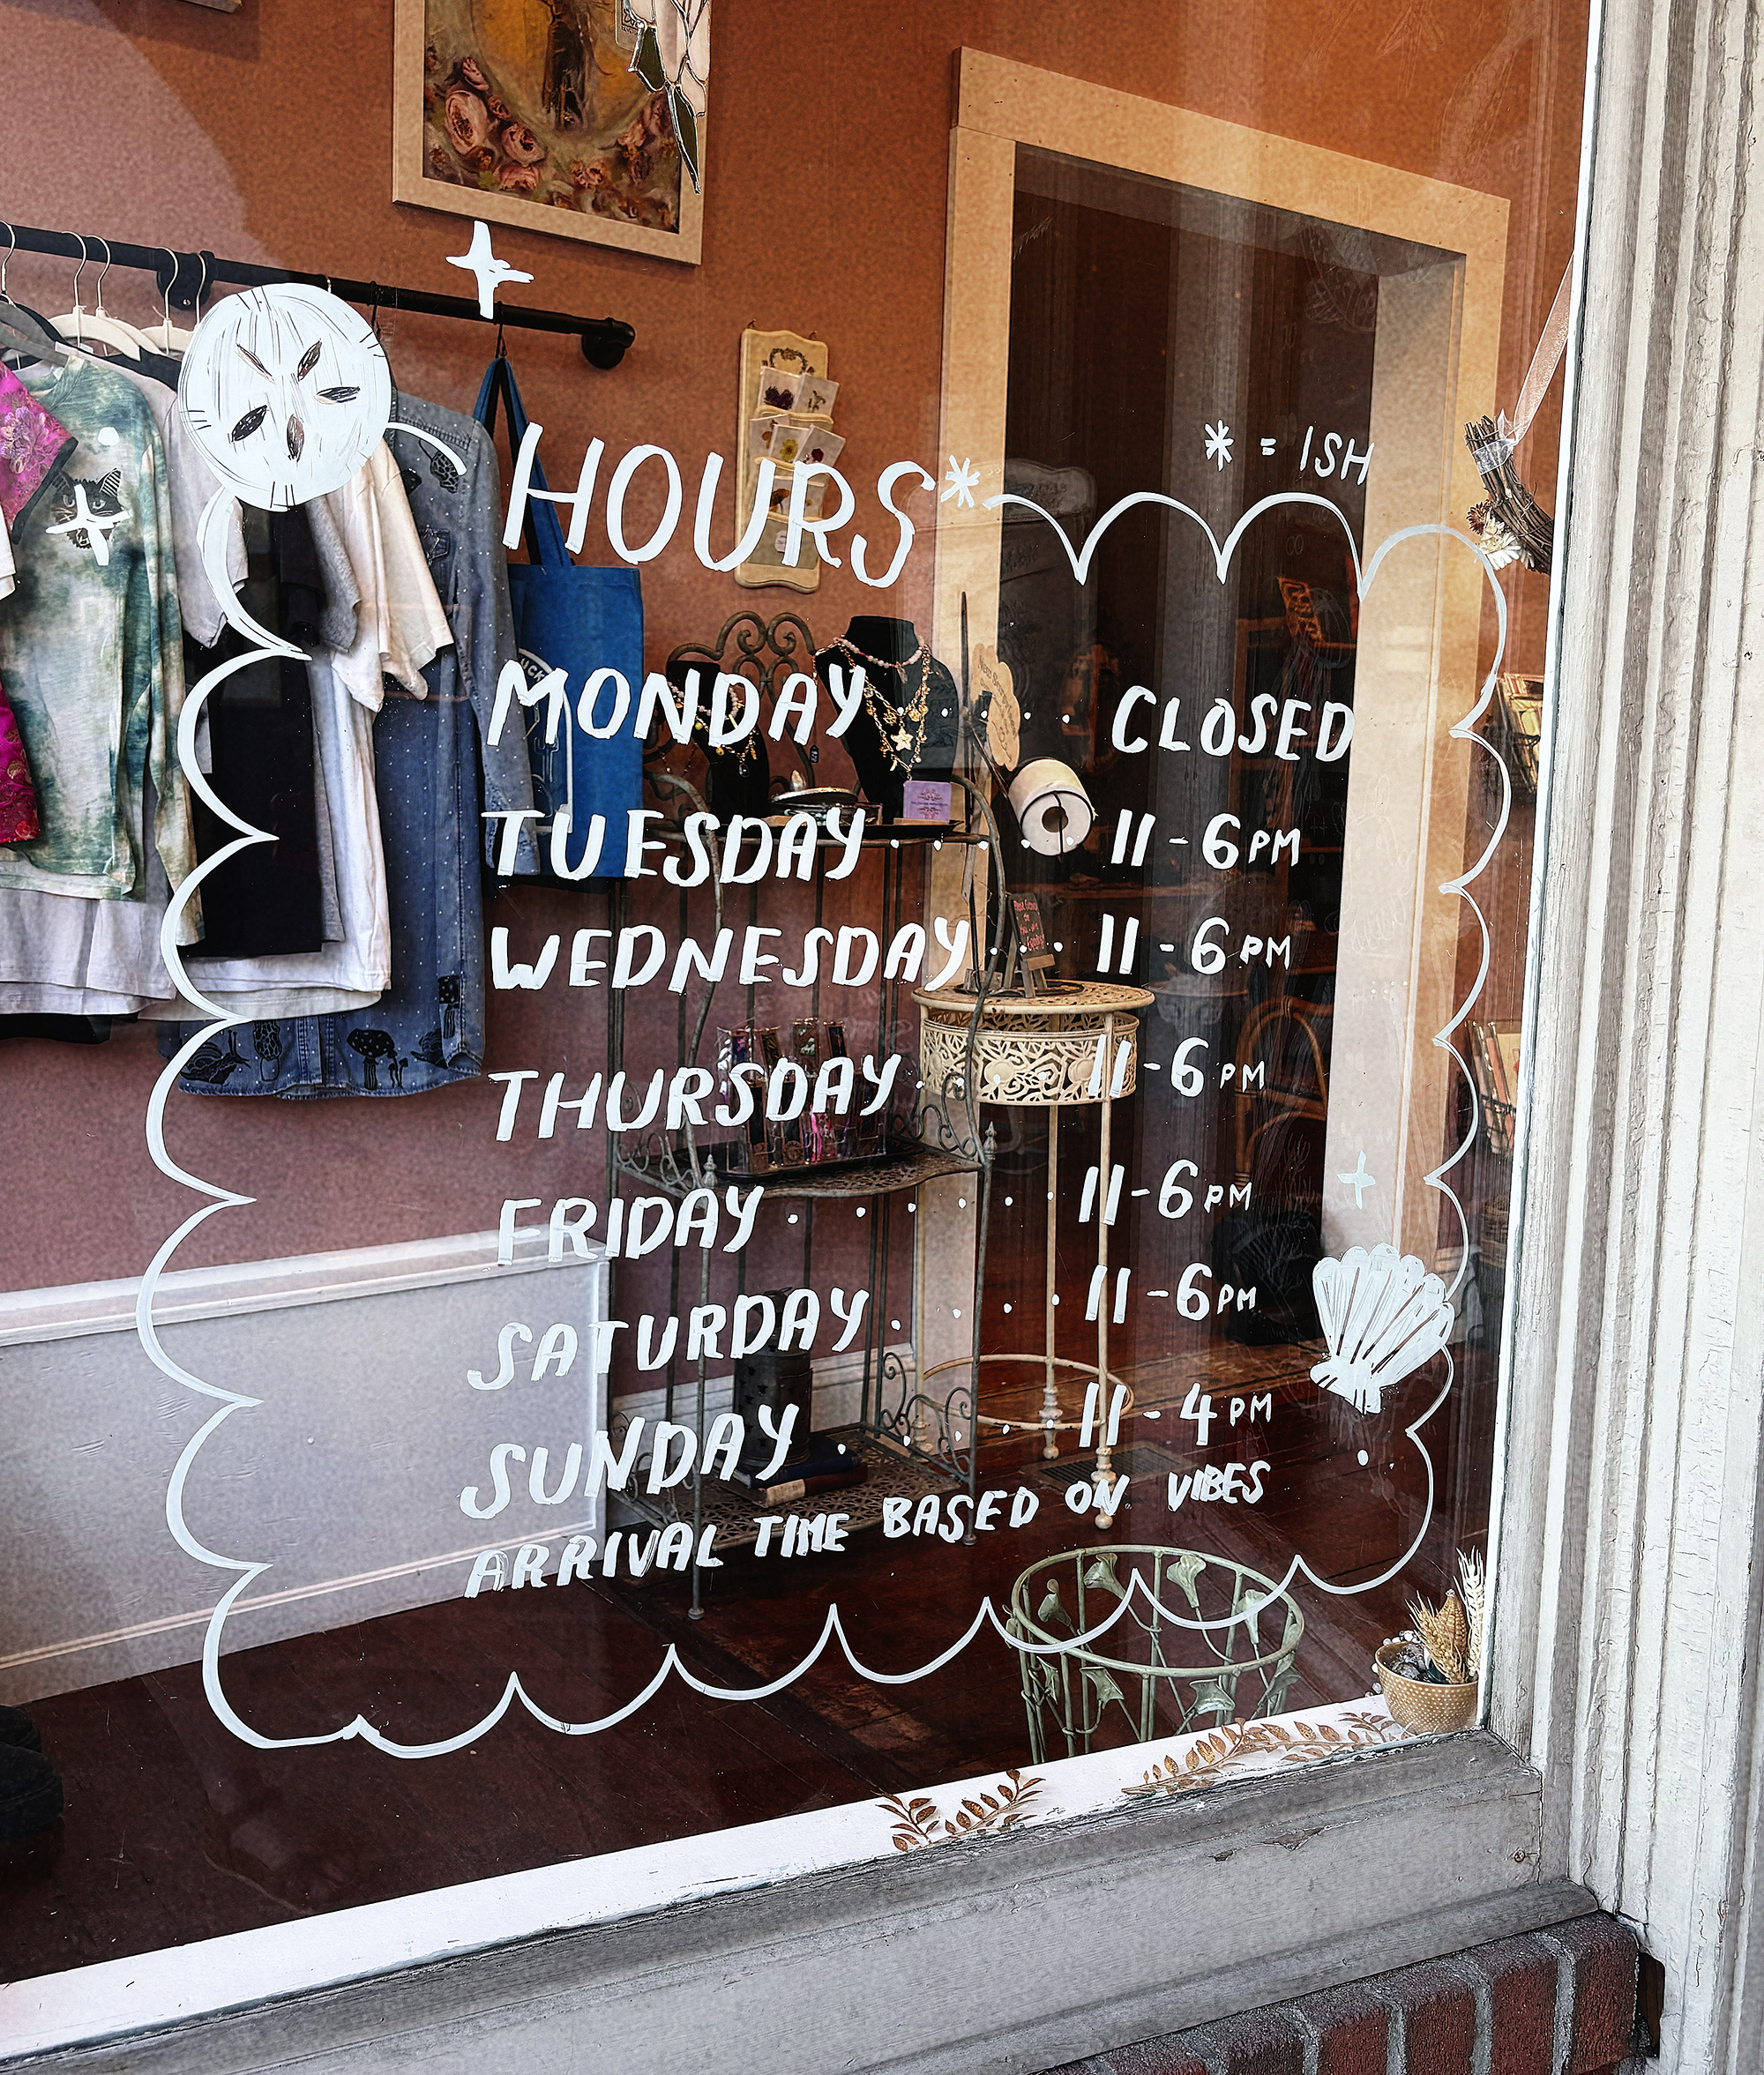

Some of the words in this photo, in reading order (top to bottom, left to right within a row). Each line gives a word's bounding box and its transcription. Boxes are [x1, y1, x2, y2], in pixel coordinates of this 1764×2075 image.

[1299, 426, 1375, 485] ISH
[486, 660, 866, 748] MONDAY
[1112, 686, 1355, 761] CLOSED
[482, 807, 866, 887] TUESDAY
[490, 916, 970, 994] WEDNESDAY
[488, 1054, 901, 1141] THURSDAY
[497, 1185, 764, 1265] FRIDAY
[467, 1288, 870, 1391] SATURDAY
[460, 1404, 799, 1519] SUNDAY
[464, 1522, 723, 1598] ARRIVAL
[753, 1512, 849, 1557] TIME
[883, 1487, 1039, 1543] BASED
[1065, 1474, 1131, 1516] ON
[1168, 1460, 1271, 1511] VIBES
